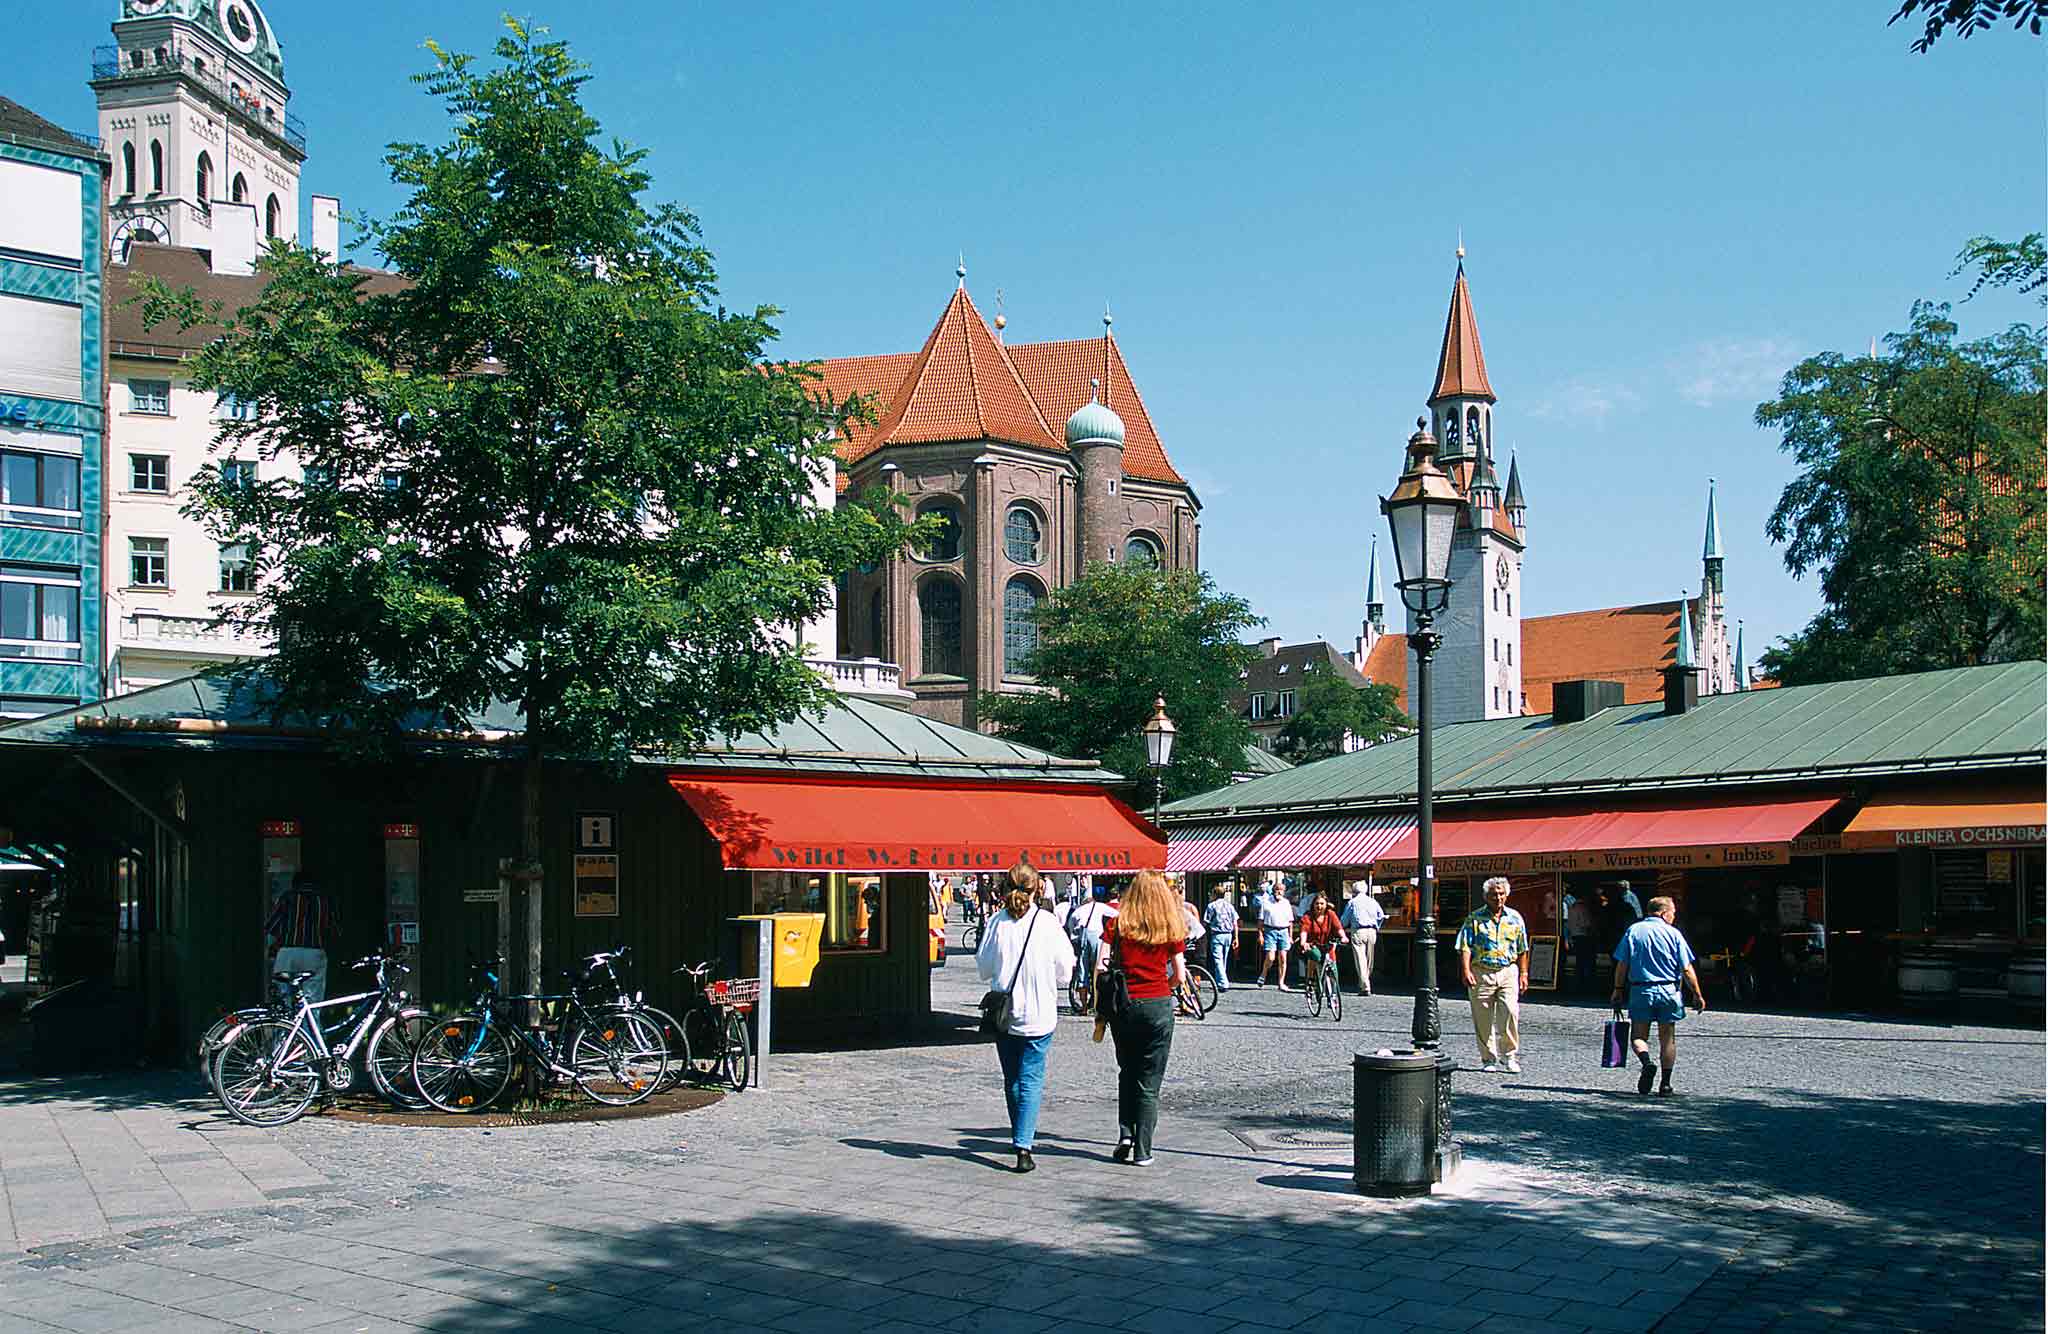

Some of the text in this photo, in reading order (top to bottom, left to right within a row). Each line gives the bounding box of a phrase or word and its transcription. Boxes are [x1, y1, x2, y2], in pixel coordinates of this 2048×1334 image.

[1895, 828, 1957, 845] KLEINER
[771, 847, 846, 865] Wild
[1531, 853, 1578, 870] Fleisch
[1603, 850, 1692, 867] Wurstwaren
[1722, 845, 1777, 863] Imbiss
